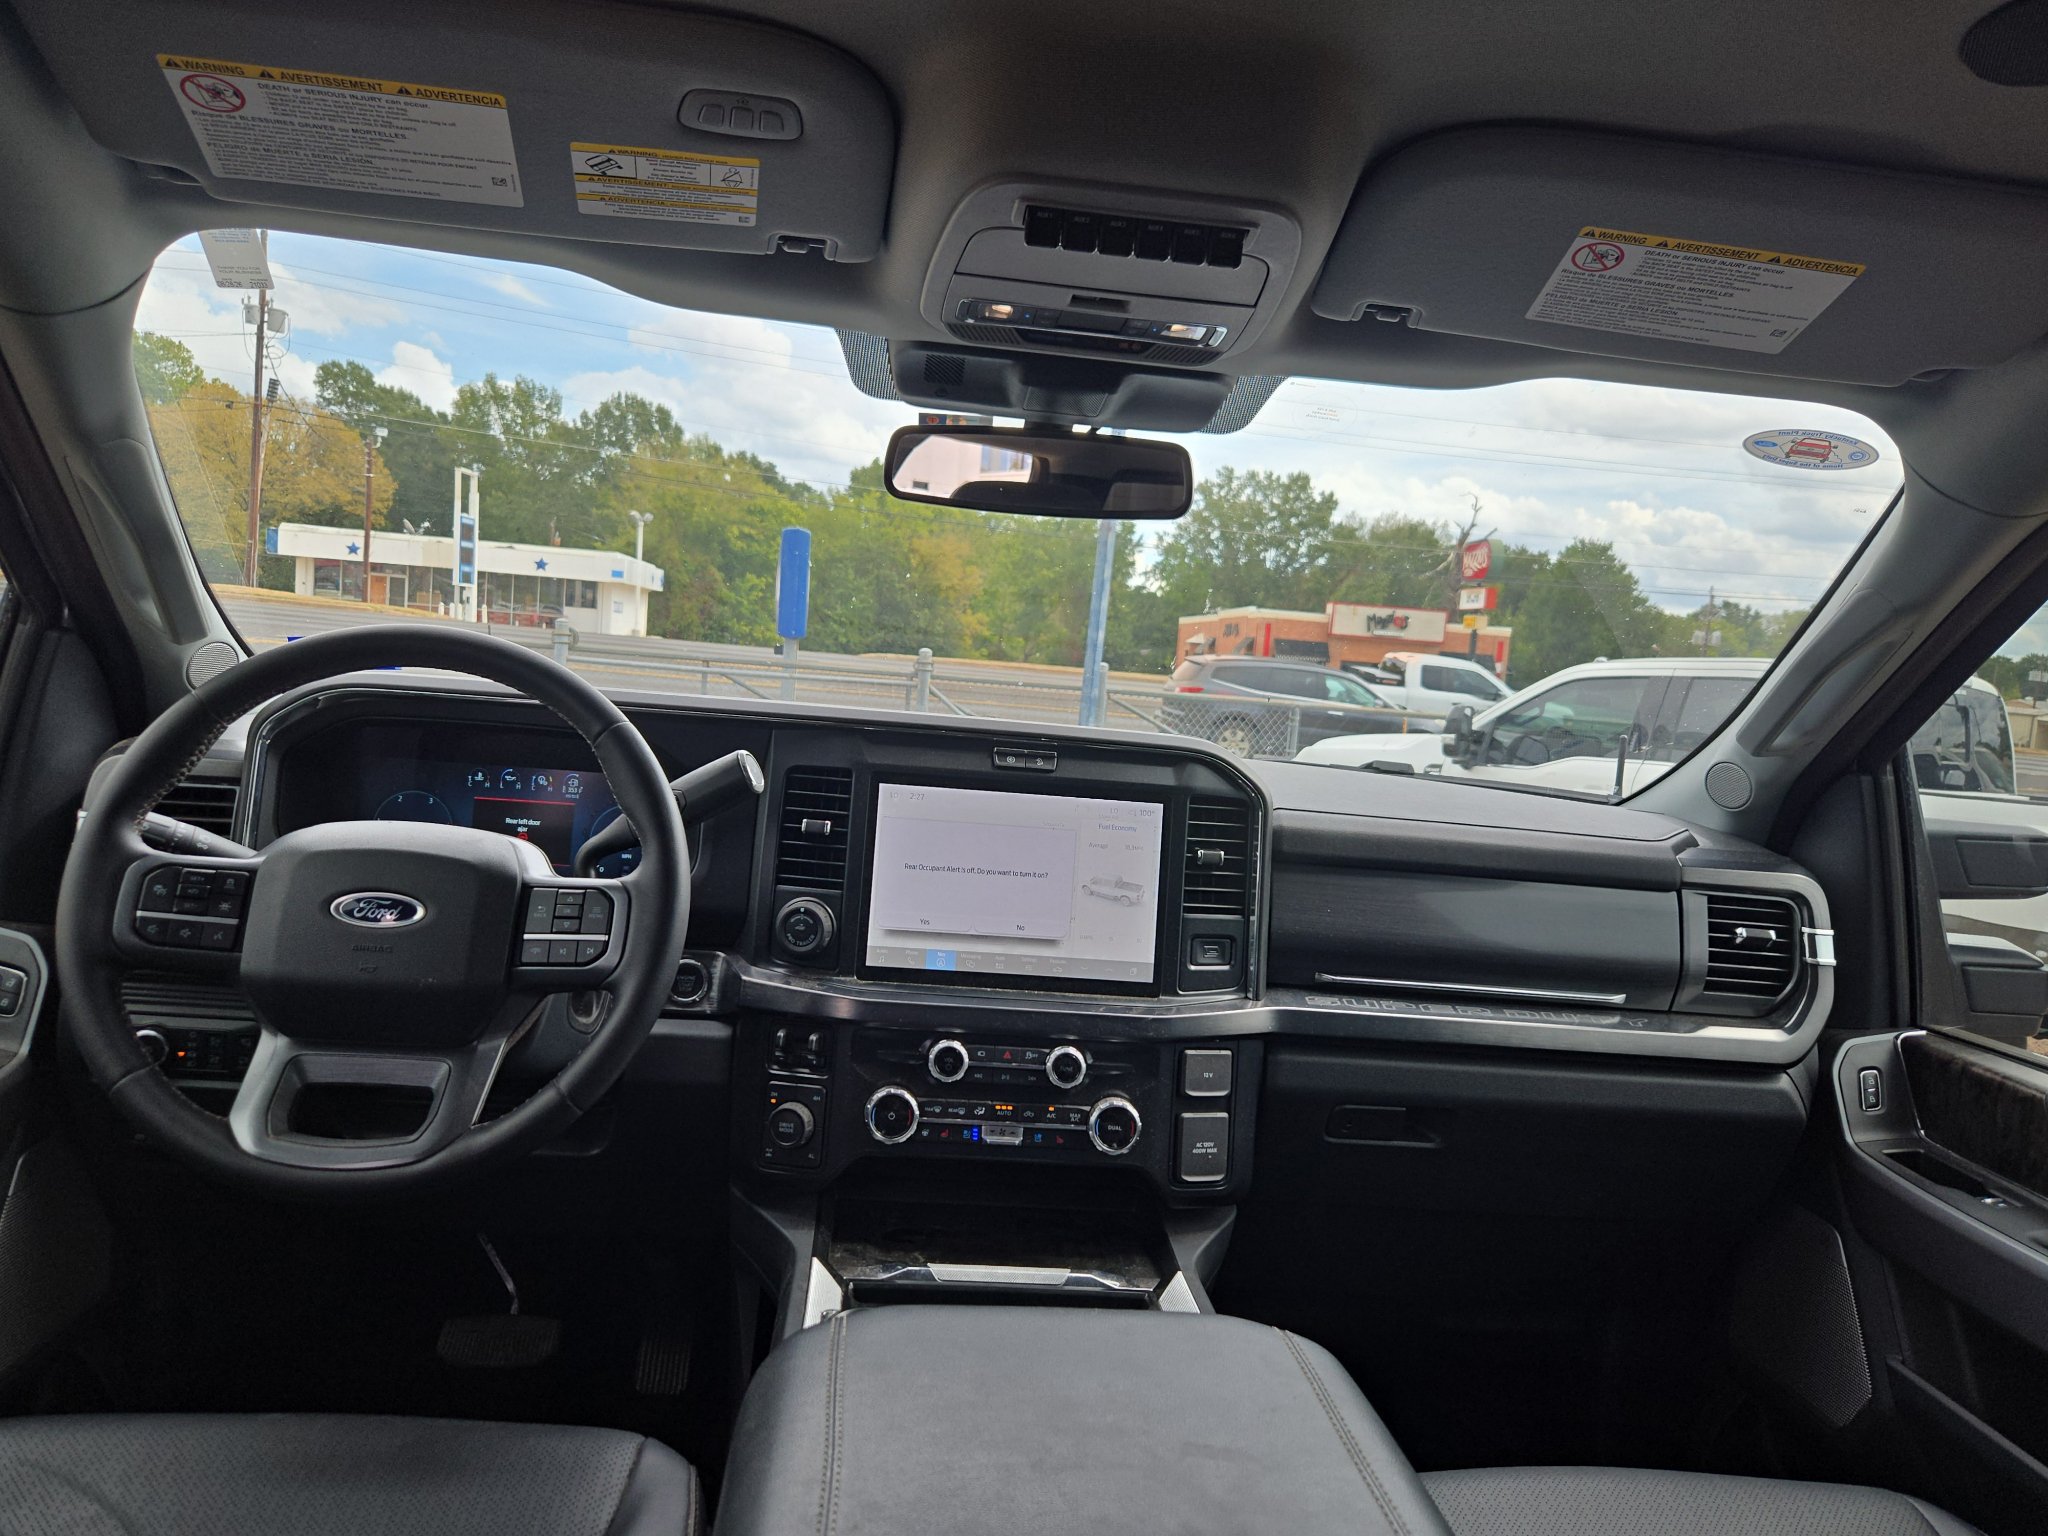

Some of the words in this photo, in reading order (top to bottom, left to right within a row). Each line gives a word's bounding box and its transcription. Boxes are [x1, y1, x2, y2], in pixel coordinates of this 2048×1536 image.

[182, 59, 245, 76] WARNING
[280, 71, 384, 92] AVERTISSEMENT
[258, 83, 290, 93] DEATH
[305, 89, 346, 99] SERIOUS
[349, 92, 382, 102] INJURY
[416, 88, 502, 106] ADVERTENCIA
[1598, 231, 1648, 245] WARNING
[1644, 250, 1671, 258] DEATH
[1681, 255, 1718, 265] SERIOUS
[1718, 260, 1747, 269] INJURY
[1674, 242, 1762, 260] AVERTISSEMENT
[1784, 257, 1859, 275] ADVERTENCIA
[1598, 273, 1643, 284] BLESSURES
[1645, 280, 1675, 289] GRAVES
[909, 792, 926, 800] 2:27
[505, 817, 517, 825] Rear
[518, 818, 526, 826] left
[1111, 824, 1138, 833] Economy
[918, 864, 946, 873] Occupant
[946, 865, 960, 873] Alert
[353, 898, 402, 920] Ford
[920, 918, 930, 926] Yes
[786, 933, 796, 944] PRO
[796, 934, 816, 946] TRAILER
[1305, 995, 1493, 1017] SUPER
[1503, 1008, 1621, 1025] DUTY
